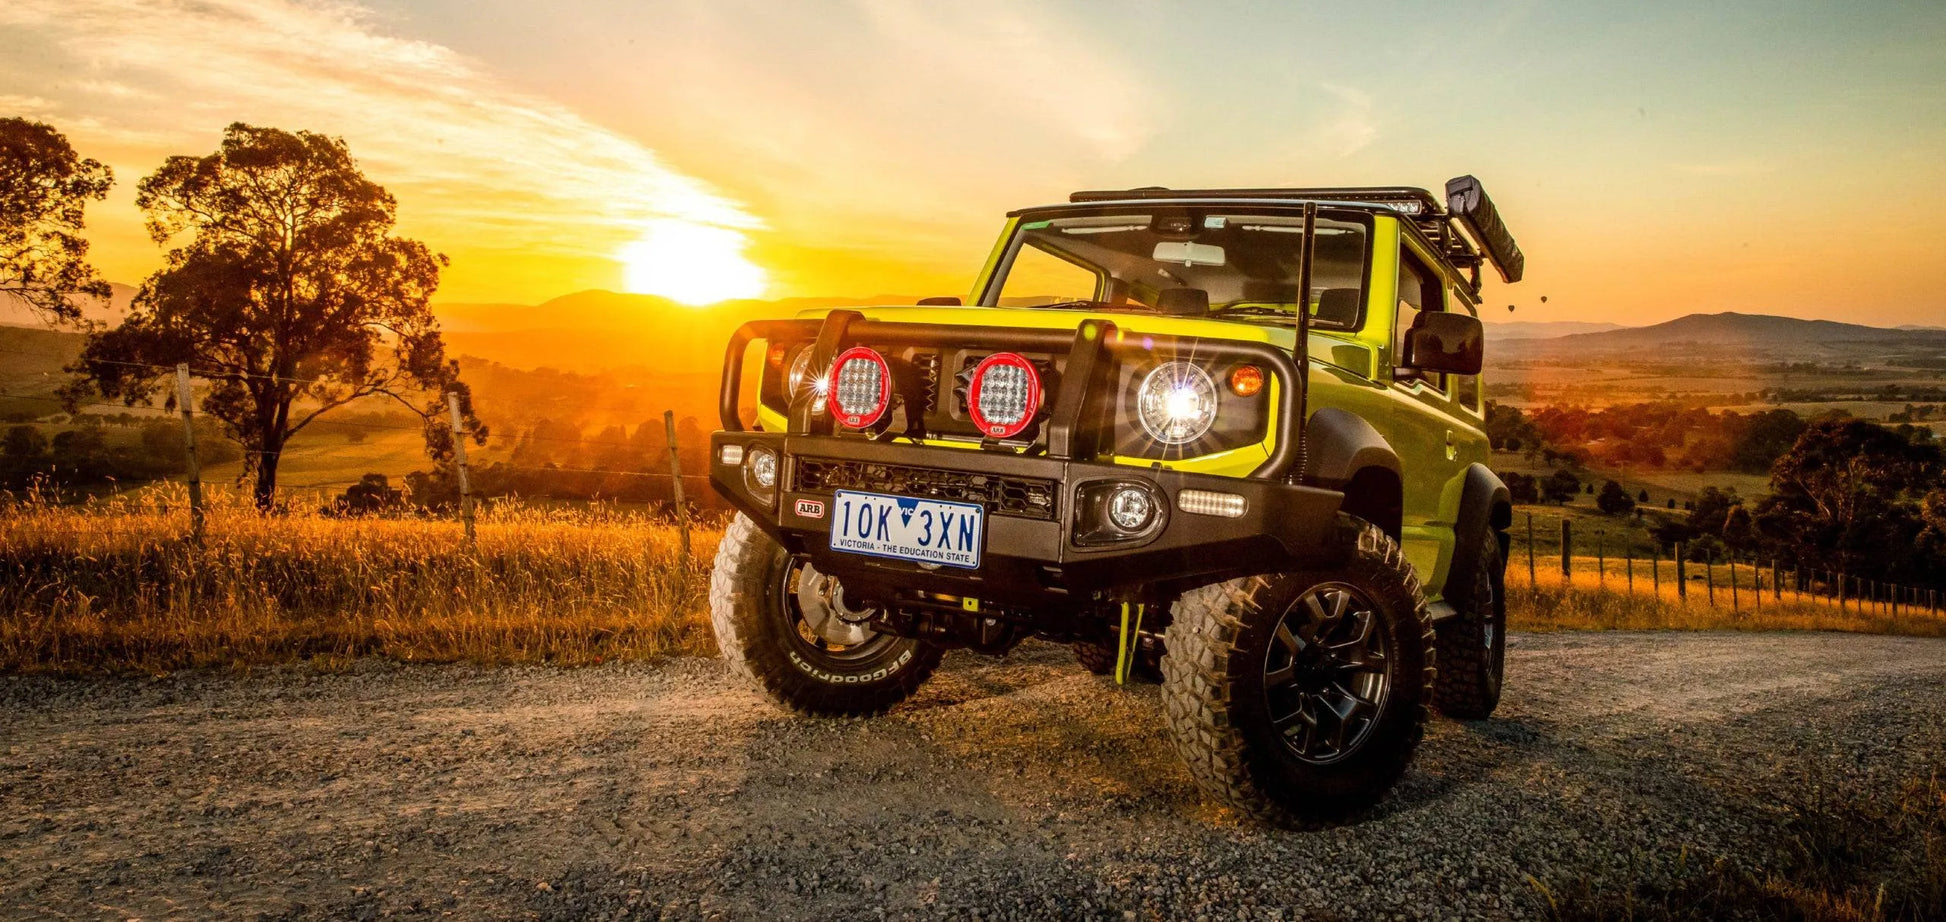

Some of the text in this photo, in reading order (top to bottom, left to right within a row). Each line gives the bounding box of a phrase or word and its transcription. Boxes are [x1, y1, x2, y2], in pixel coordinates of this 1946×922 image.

[799, 503, 821, 515] ARB
[899, 506, 914, 516] VIC
[917, 510, 975, 552] 3XN
[839, 538, 875, 550] VICTORIA
[882, 543, 897, 553] THE
[899, 546, 944, 560] EDUCATION
[946, 552, 970, 563] STATE
[789, 649, 912, 684] BFGoodrich
